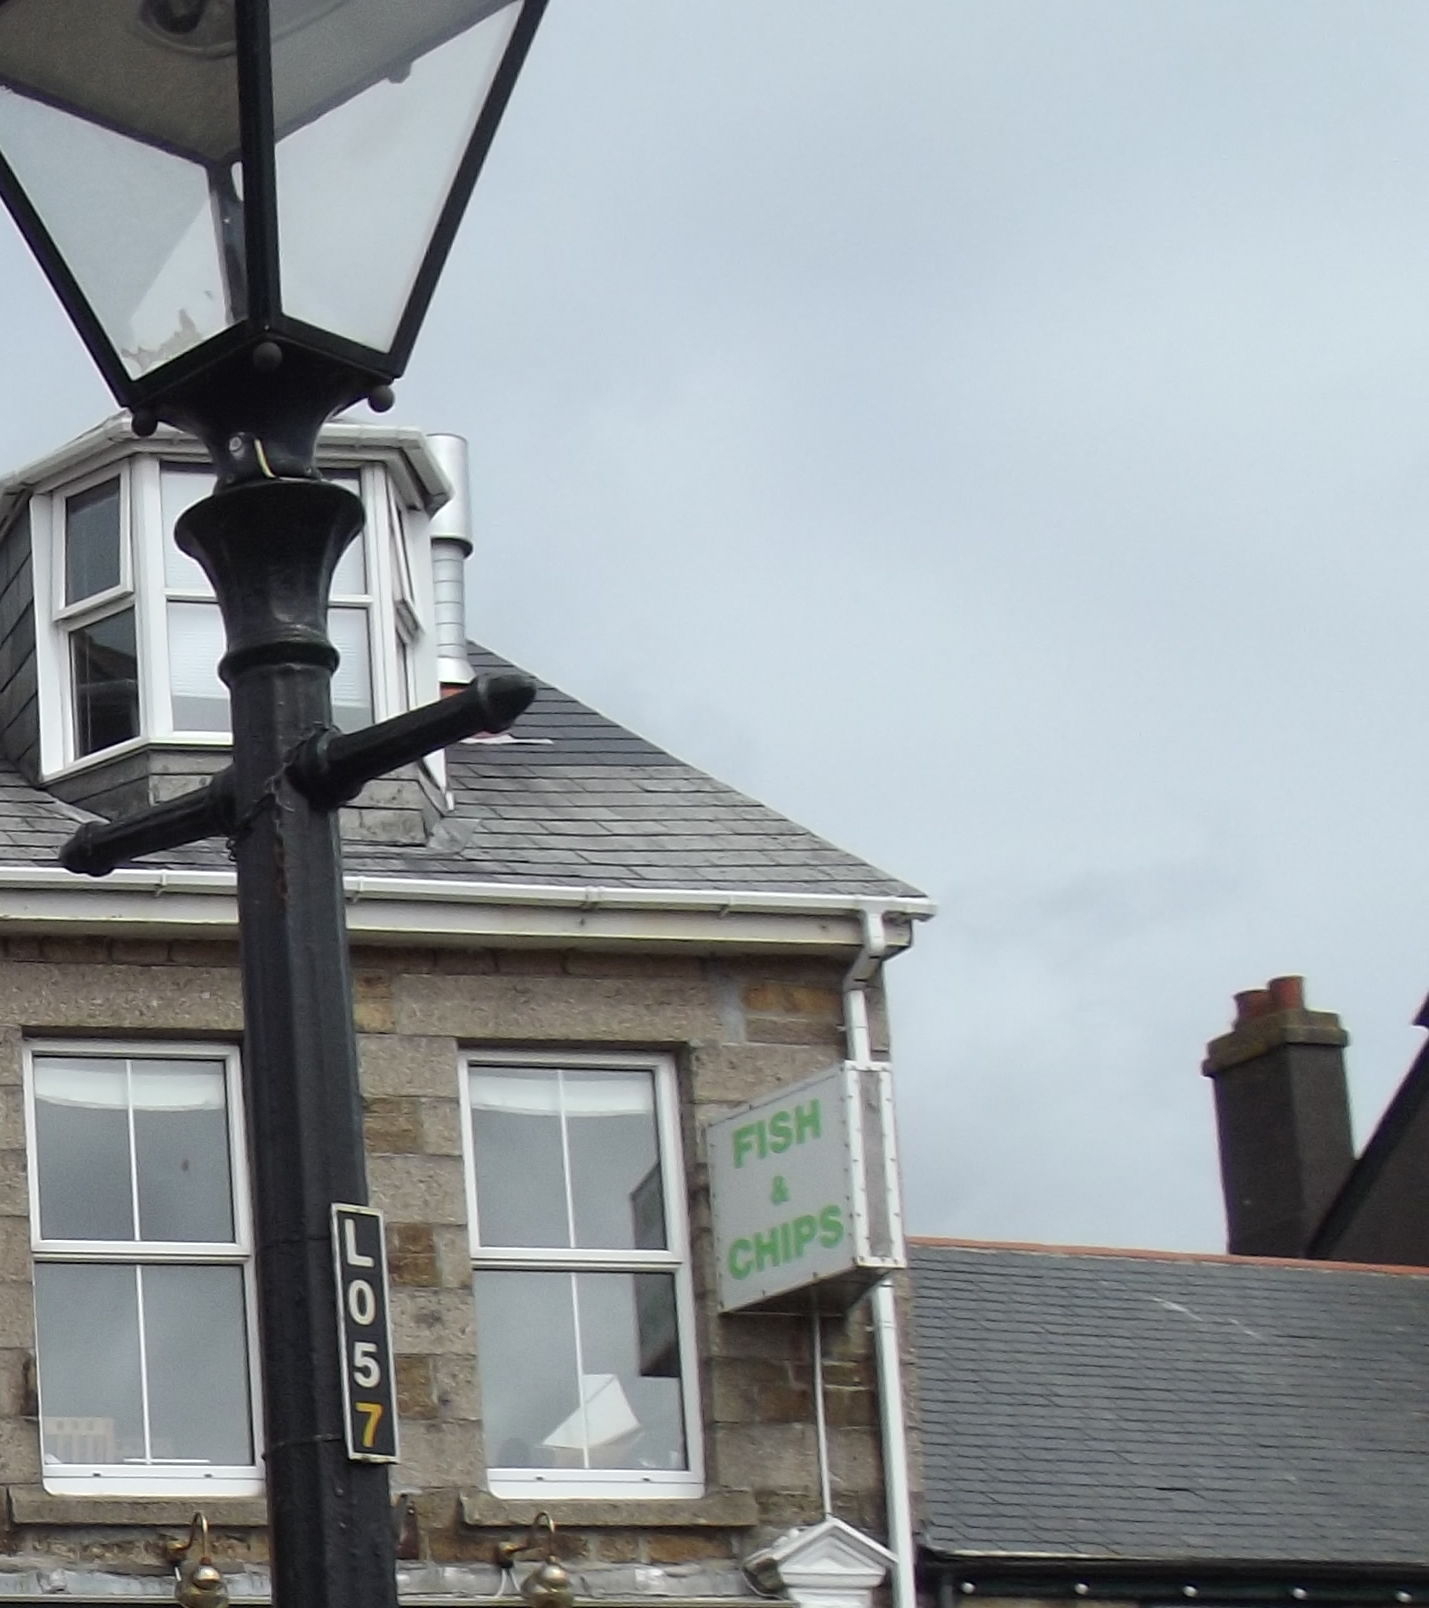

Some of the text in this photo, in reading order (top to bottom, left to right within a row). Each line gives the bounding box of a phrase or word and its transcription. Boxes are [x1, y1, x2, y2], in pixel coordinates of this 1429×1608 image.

[733, 1098, 822, 1169] FISH
[770, 1175, 789, 1206] &
[728, 1204, 845, 1280] CHIPS
